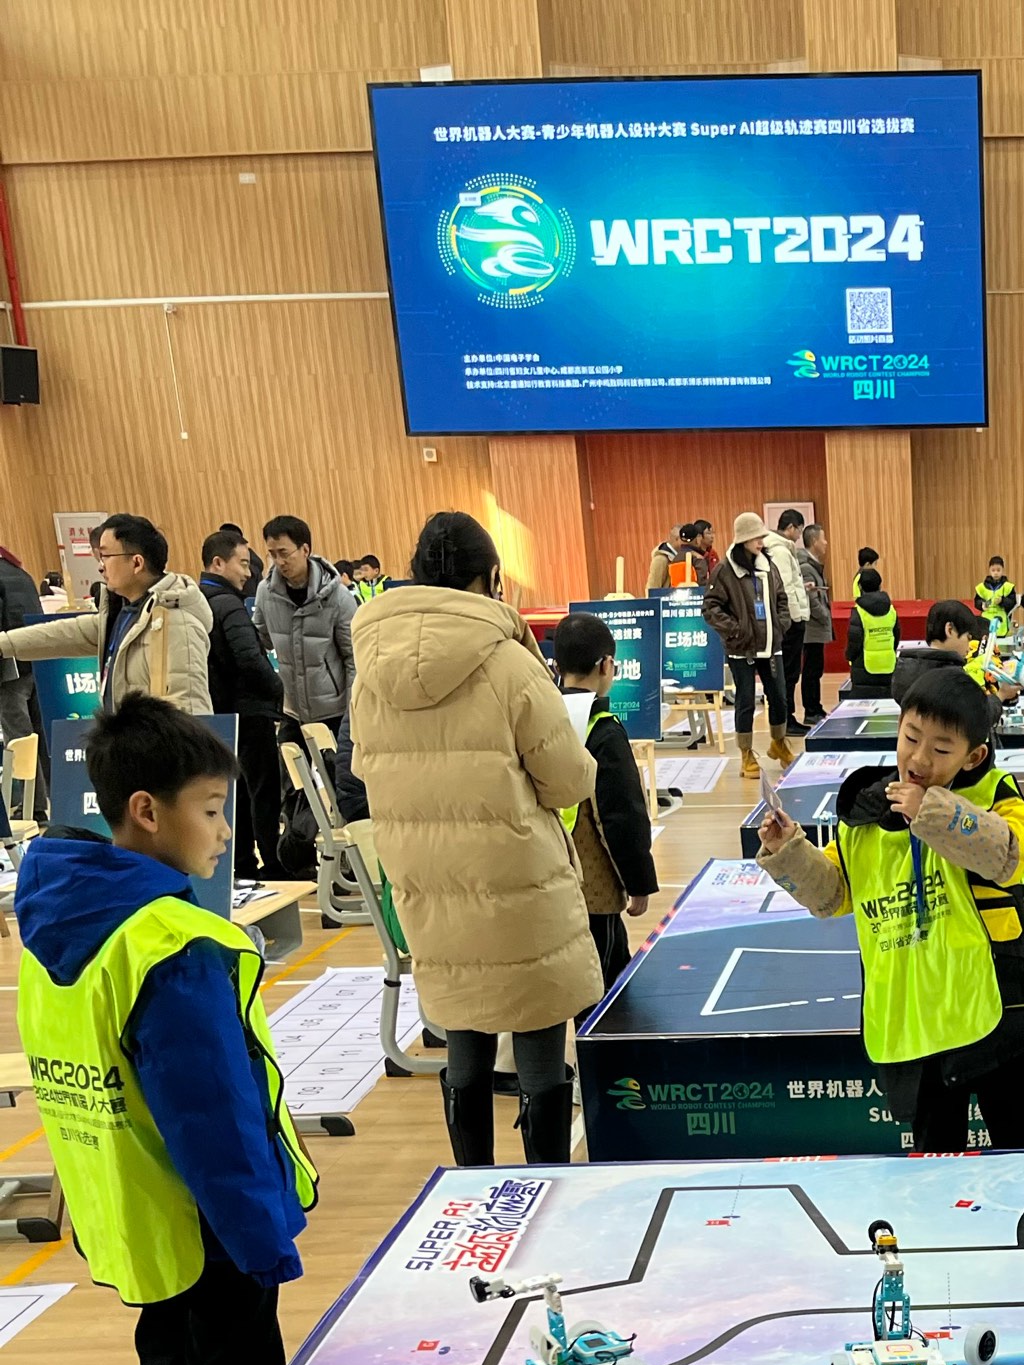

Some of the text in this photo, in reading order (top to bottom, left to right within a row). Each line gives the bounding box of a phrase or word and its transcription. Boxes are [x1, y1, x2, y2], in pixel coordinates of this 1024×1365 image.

[433, 121, 688, 142] 世界机器人大赛-青少年机器人设计大赛
[690, 122, 736, 139] Super
[590, 213, 925, 266] WRCT2024
[853, 379, 895, 400] 四川
[665, 630, 708, 649] E场地
[686, 1111, 736, 1136] 四川
[405, 1220, 461, 1271] SUPER
